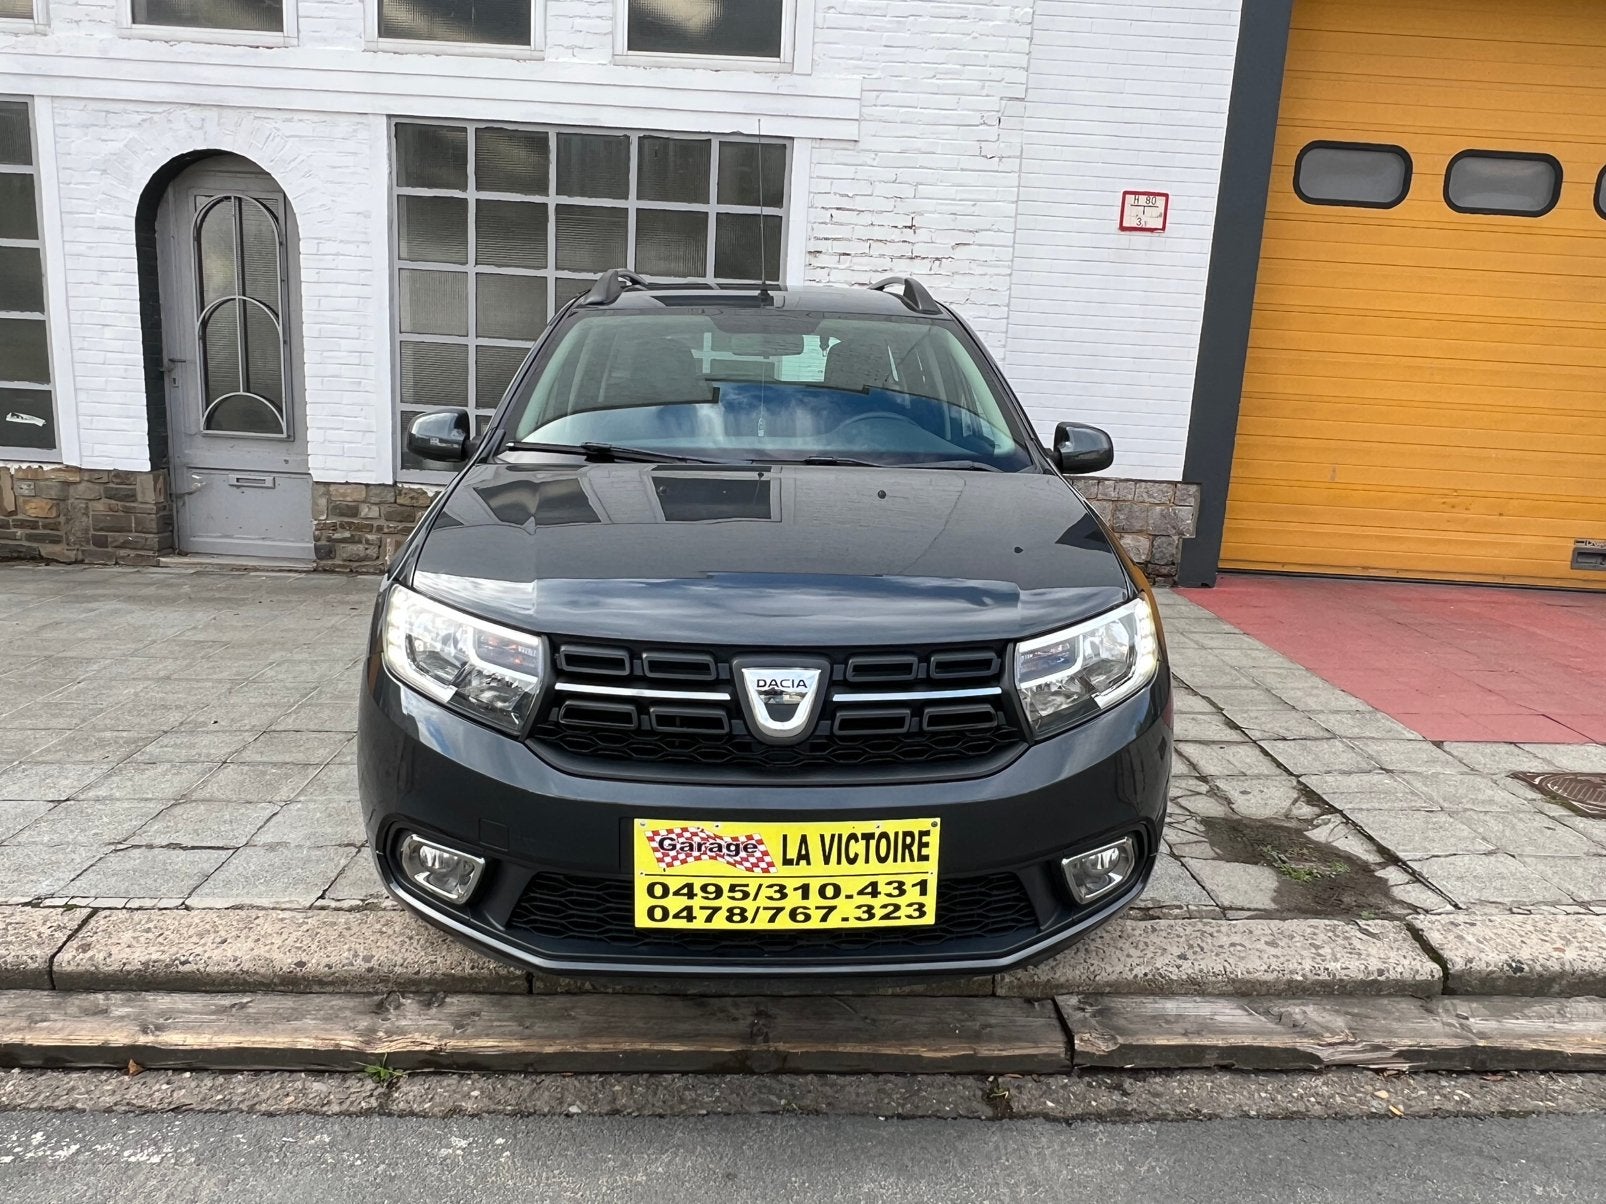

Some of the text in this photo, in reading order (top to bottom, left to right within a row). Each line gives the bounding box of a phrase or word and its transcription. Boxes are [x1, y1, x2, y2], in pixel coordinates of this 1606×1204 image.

[1133, 195, 1157, 205] H 80
[757, 679, 807, 688] DACIA
[658, 830, 930, 866] Garage LA VICTOIRE
[646, 878, 928, 901] 0495/310.431
[646, 902, 927, 924] 0478/767.323
